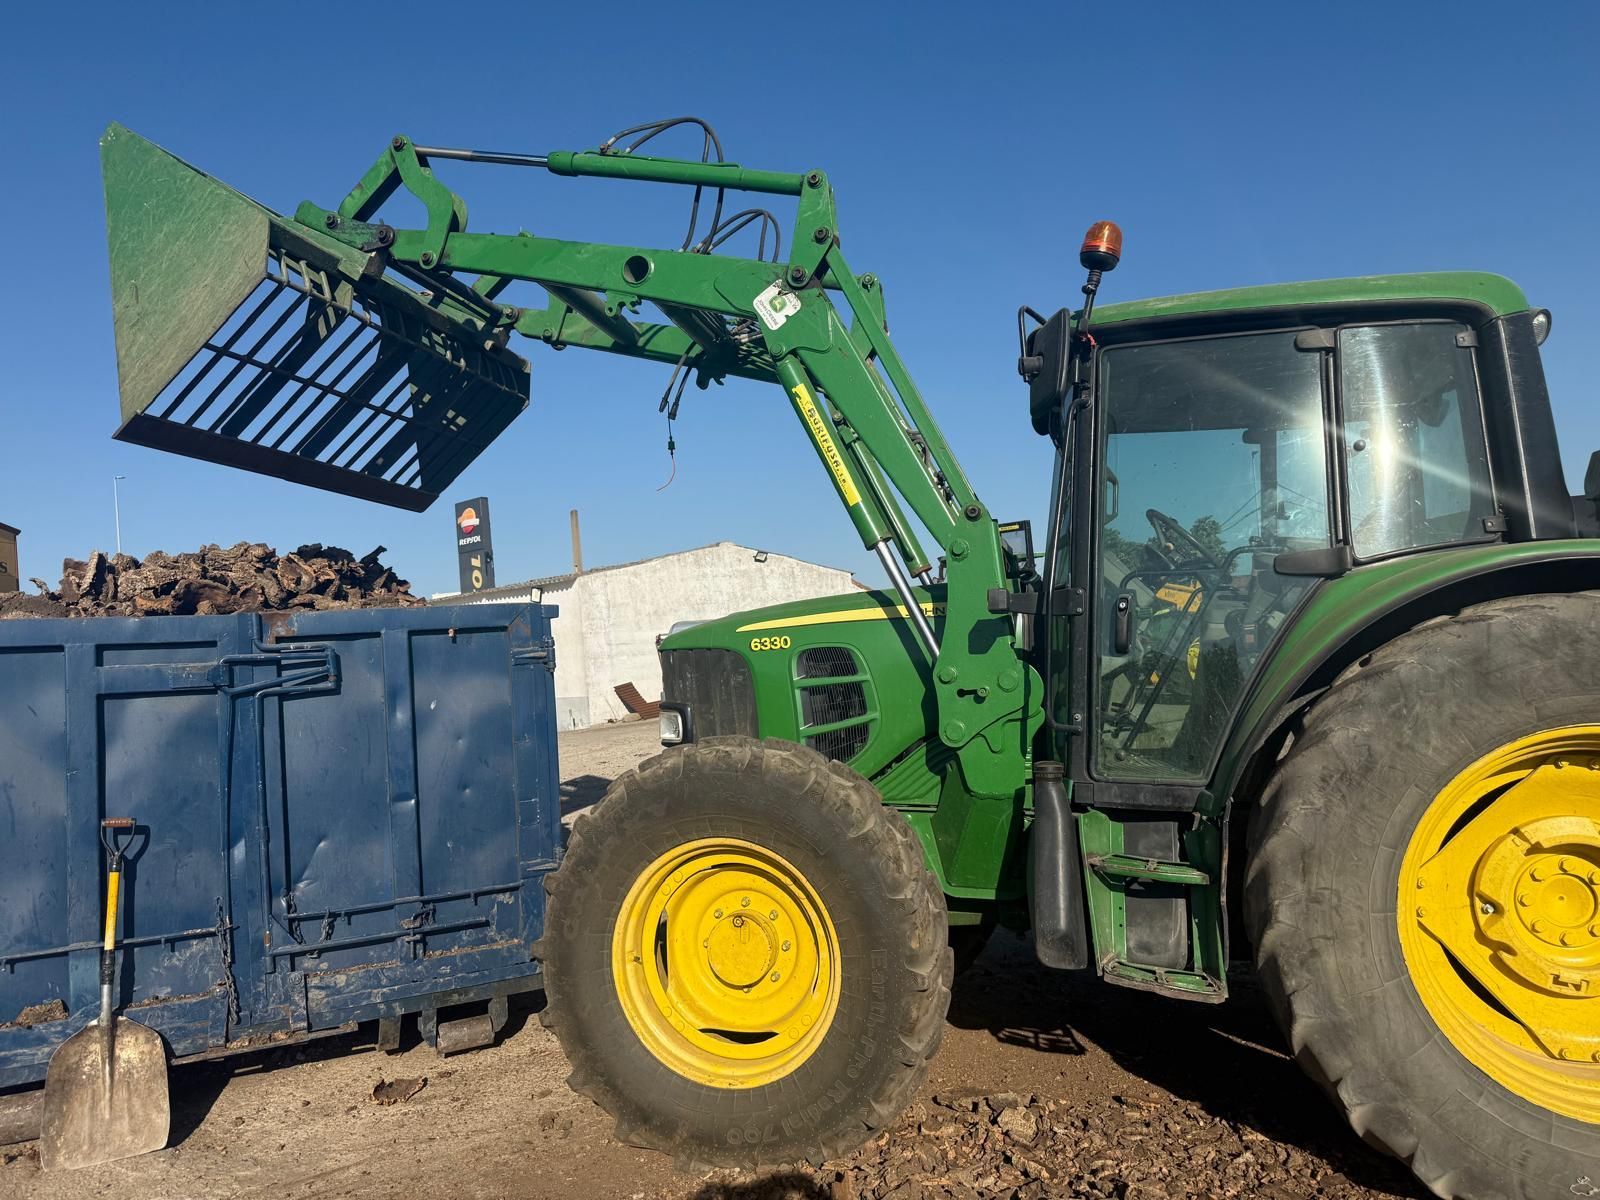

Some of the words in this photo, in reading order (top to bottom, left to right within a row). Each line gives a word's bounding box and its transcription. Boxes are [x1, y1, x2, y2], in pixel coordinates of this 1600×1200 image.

[459, 535, 481, 546] REPSOL
[471, 554, 483, 591] OL
[750, 635, 791, 652] 6330
[727, 1126, 780, 1145] 700
